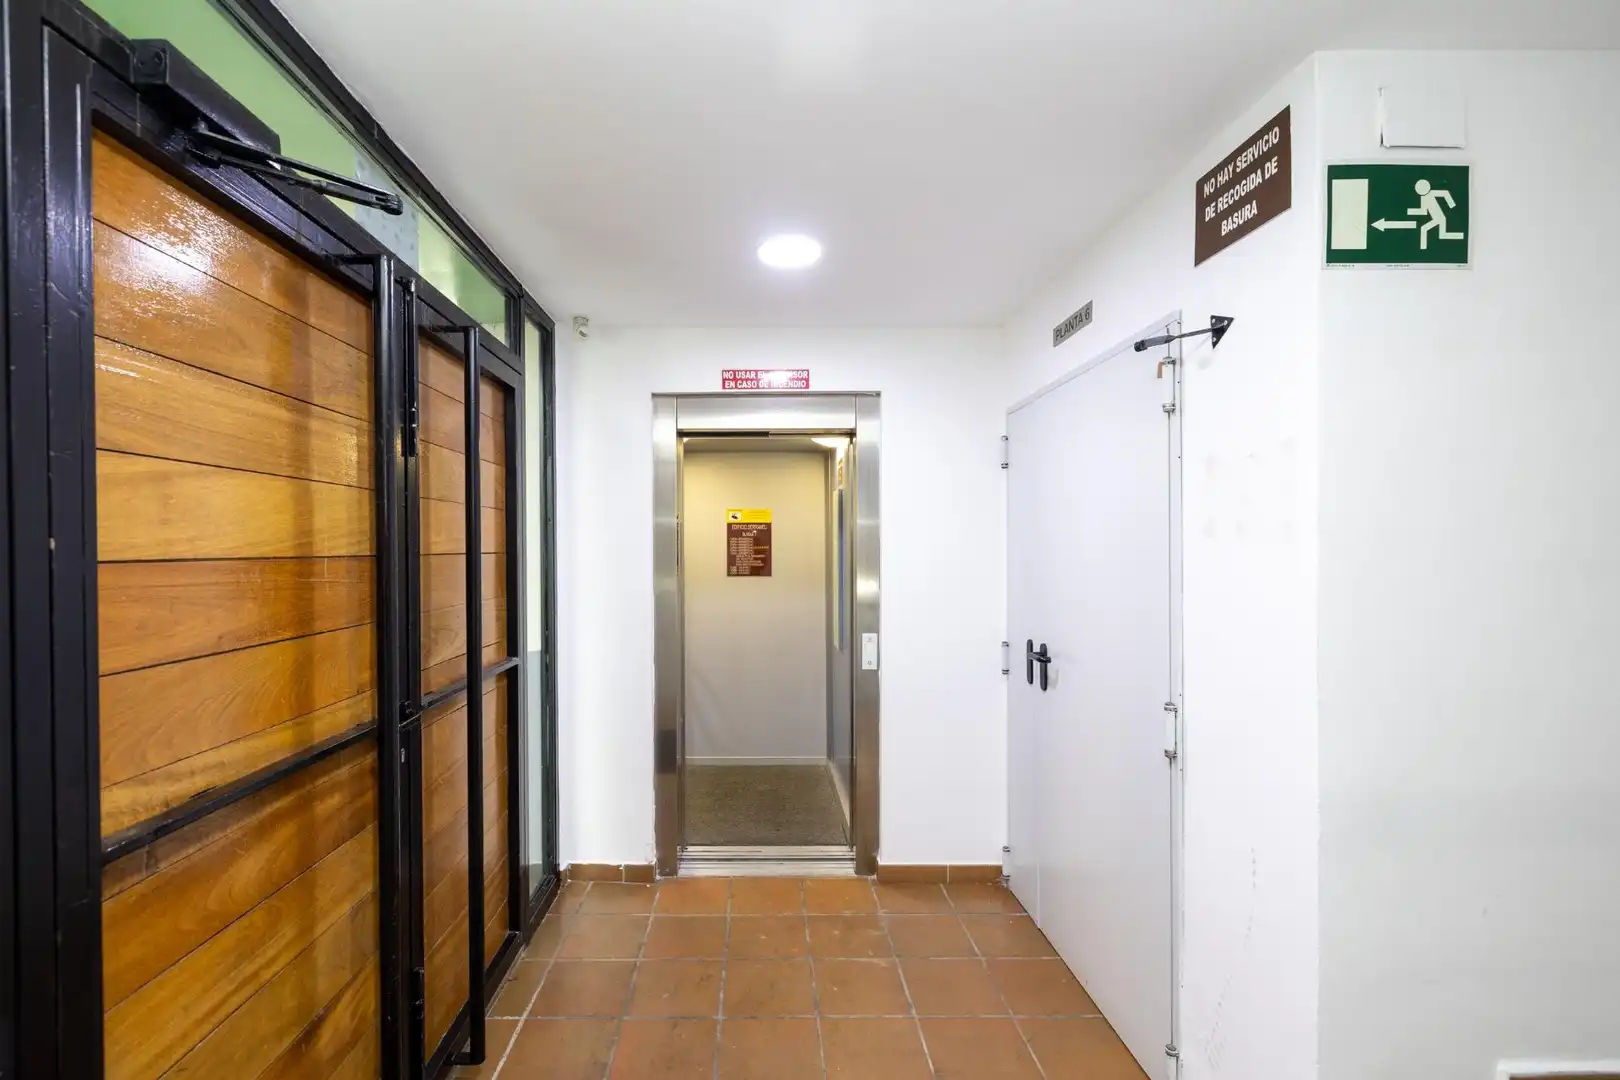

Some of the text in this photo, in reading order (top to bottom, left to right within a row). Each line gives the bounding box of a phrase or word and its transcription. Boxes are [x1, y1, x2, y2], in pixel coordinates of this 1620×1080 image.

[1203, 125, 1280, 198] NO HAY SERVICIO
[1205, 155, 1278, 222] DE RECOGIDA DE
[1221, 200, 1258, 236] BASURA
[1055, 307, 1089, 341] PLANTA 6
[723, 370, 734, 379] NO
[735, 370, 757, 379] USAR
[724, 380, 735, 389] EN
[737, 380, 757, 389] CASO
